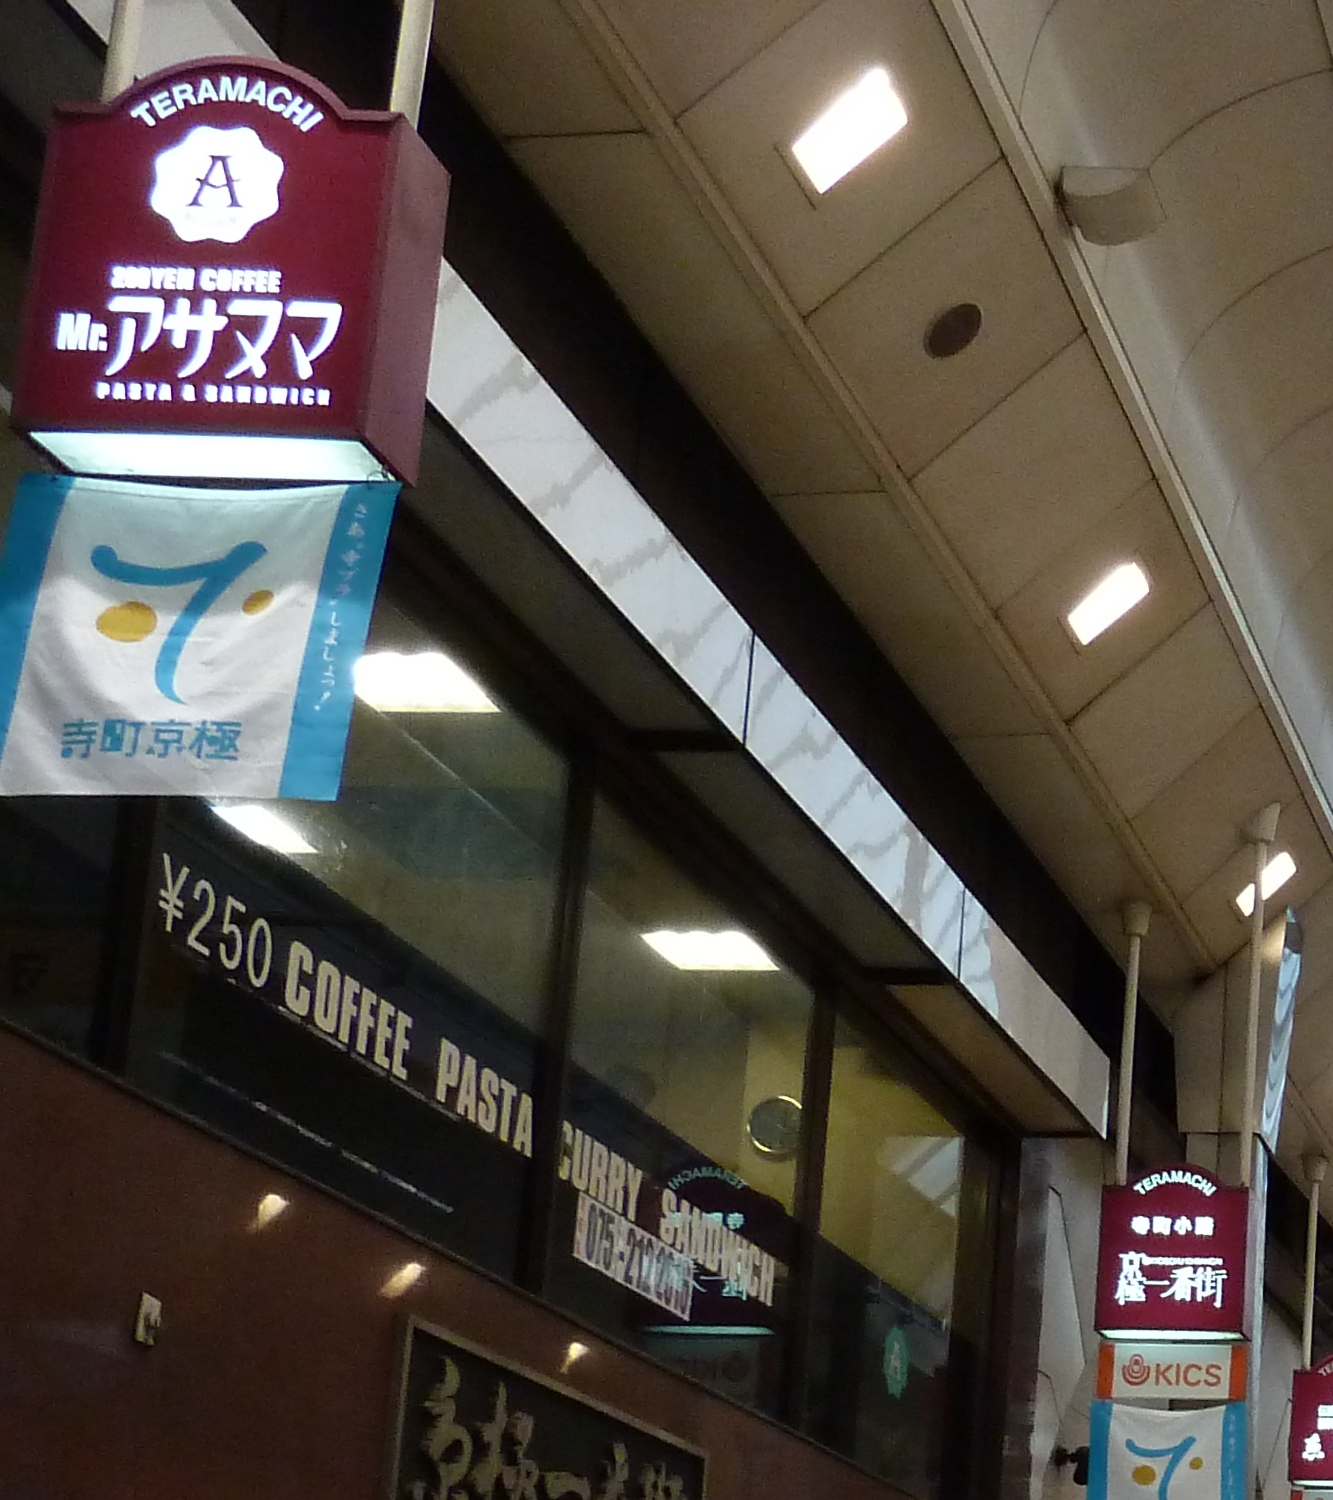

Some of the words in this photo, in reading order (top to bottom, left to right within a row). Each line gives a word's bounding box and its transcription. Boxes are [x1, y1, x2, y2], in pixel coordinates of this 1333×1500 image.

[131, 76, 324, 132] TERAMACHI
[200, 268, 282, 293] COFFEE
[106, 296, 343, 380] アサヌマ
[96, 382, 173, 402] PASTA
[181, 384, 197, 402] &
[204, 385, 331, 406] SANDWICH
[60, 718, 241, 761] 寺町京極
[284, 940, 414, 1081] COFFEE
[436, 1037, 534, 1158] PASTA
[1133, 1170, 1218, 1196] TERAMACHI
[558, 1119, 643, 1222] CURRY
[659, 1188, 777, 1307] SANDWICH
[1154, 1363, 1223, 1387] KICS
